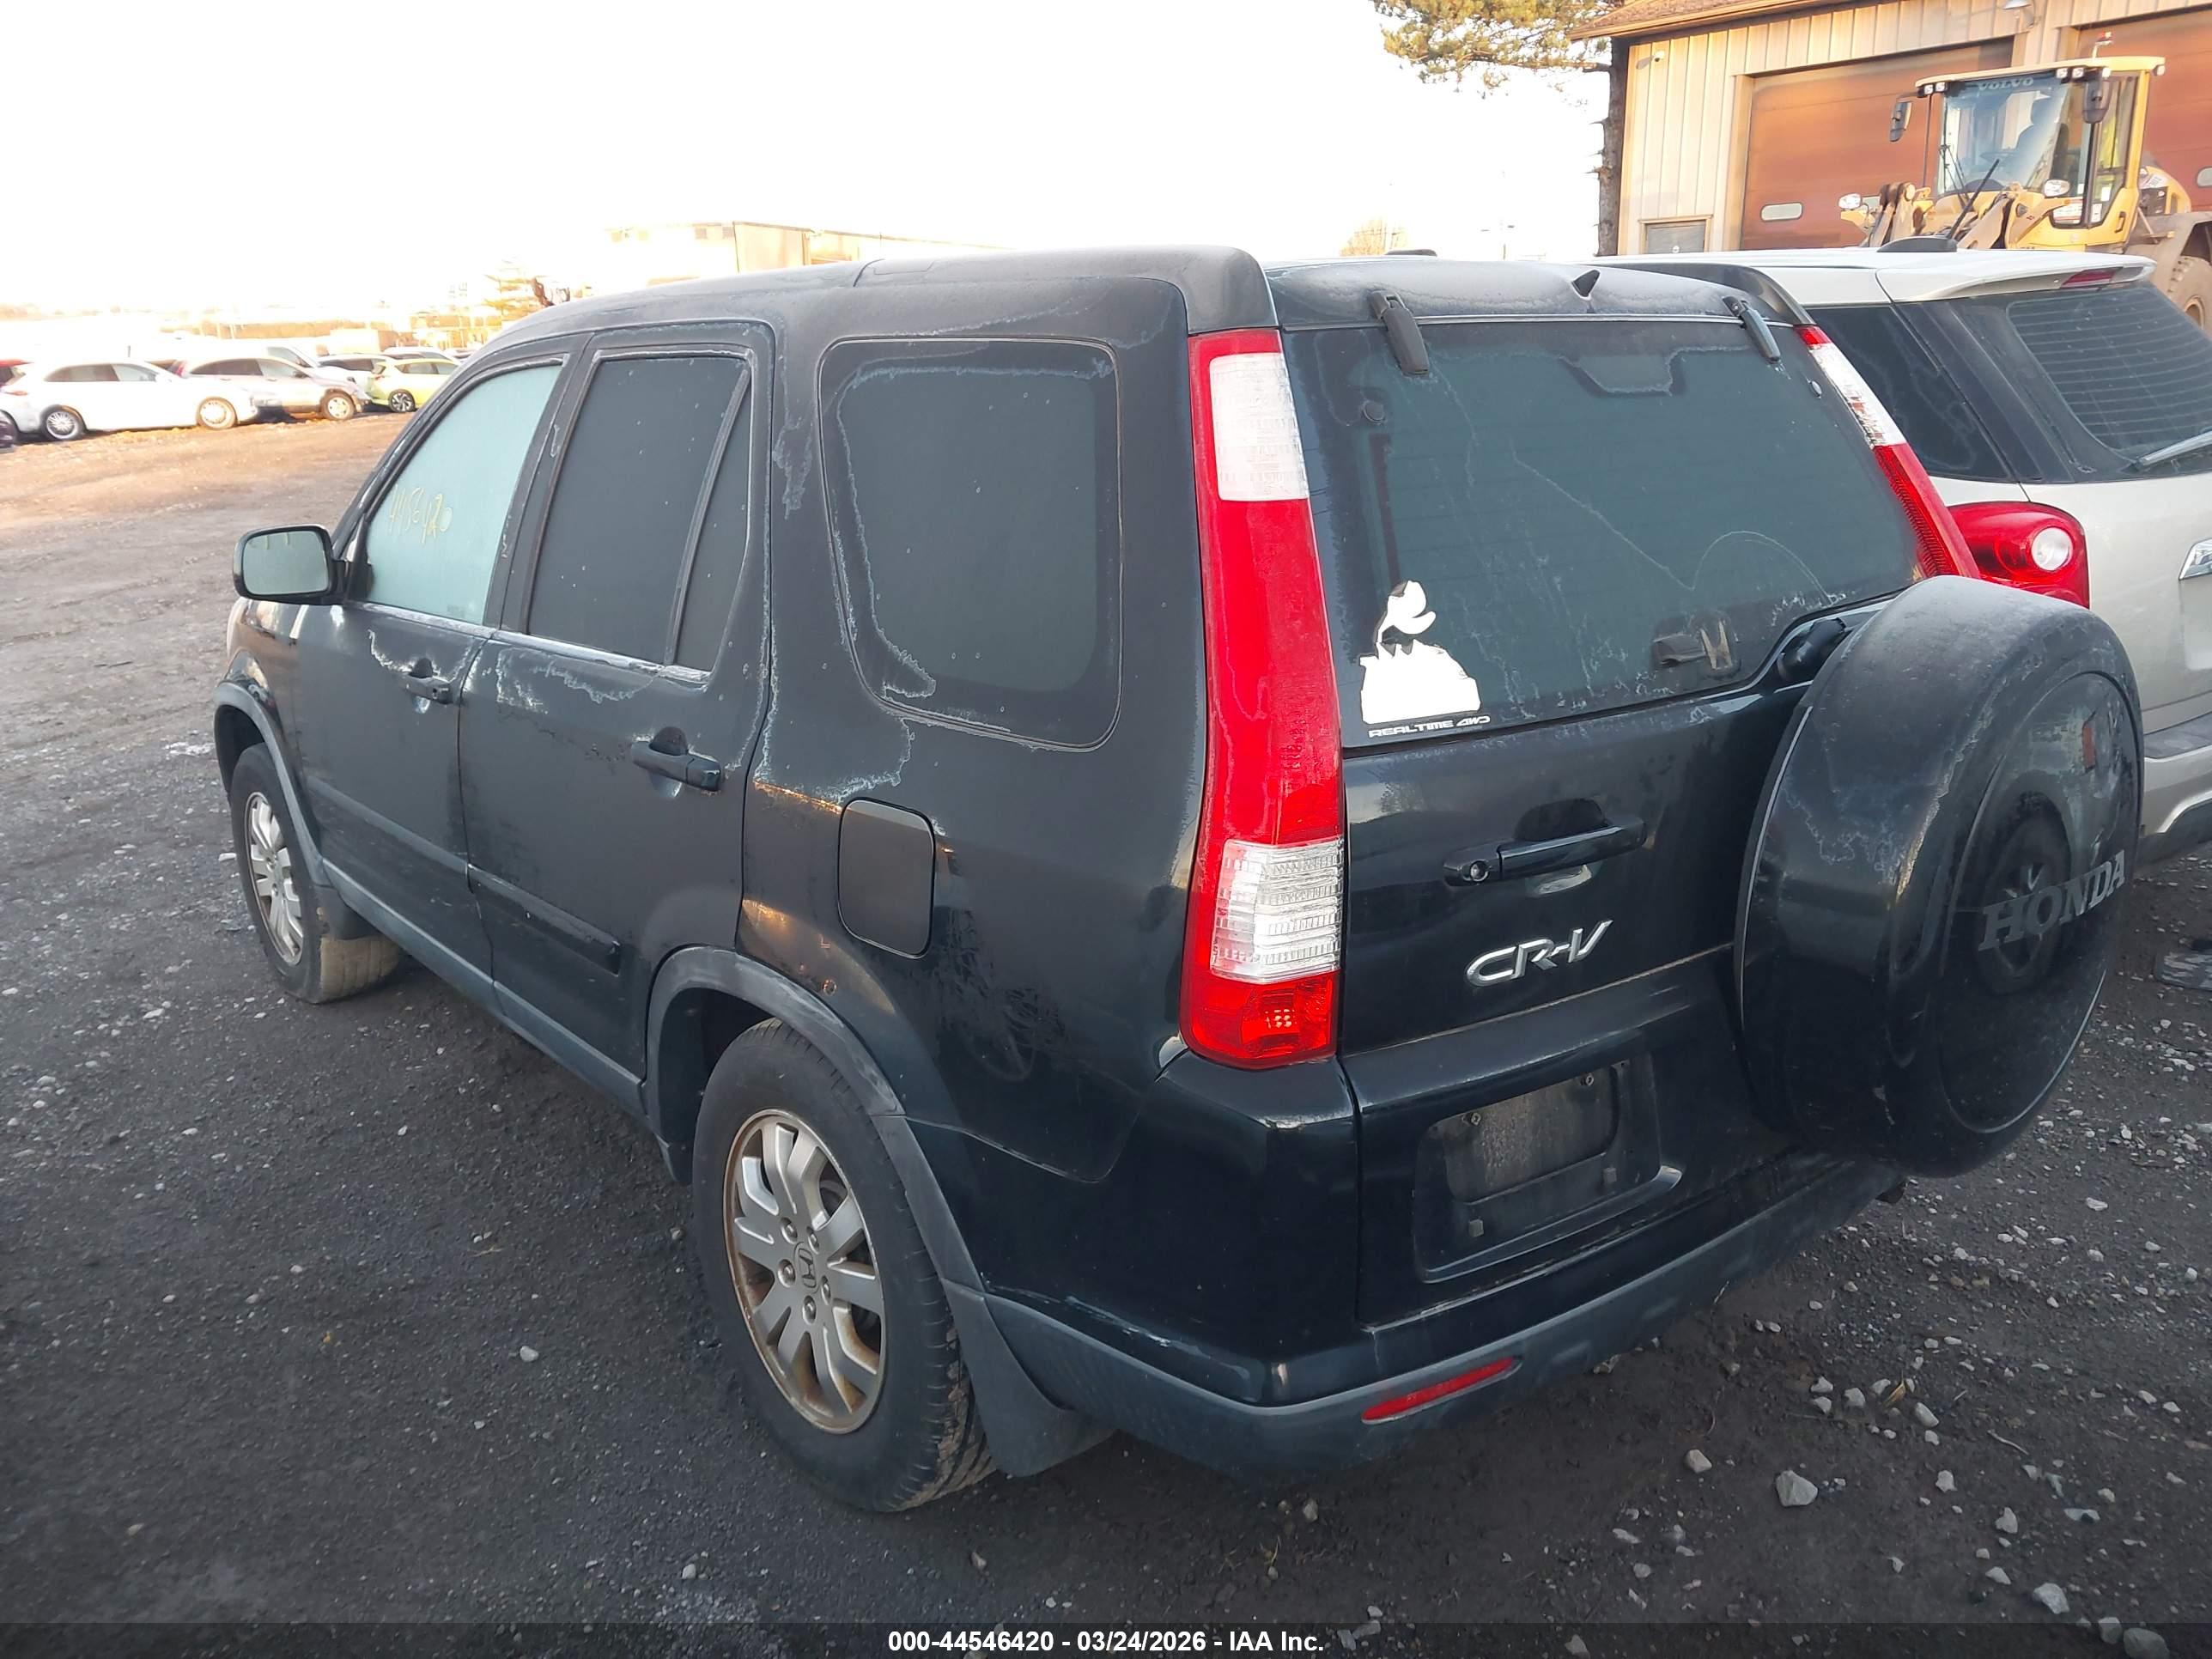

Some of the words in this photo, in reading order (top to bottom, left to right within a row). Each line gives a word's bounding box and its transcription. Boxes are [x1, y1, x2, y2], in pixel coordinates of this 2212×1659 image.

[1978, 76, 2034, 91] VOLVO
[1368, 720, 1454, 738] REALTIME
[1978, 849, 2125, 951] HONDA
[1465, 919, 1613, 988] CR-V
